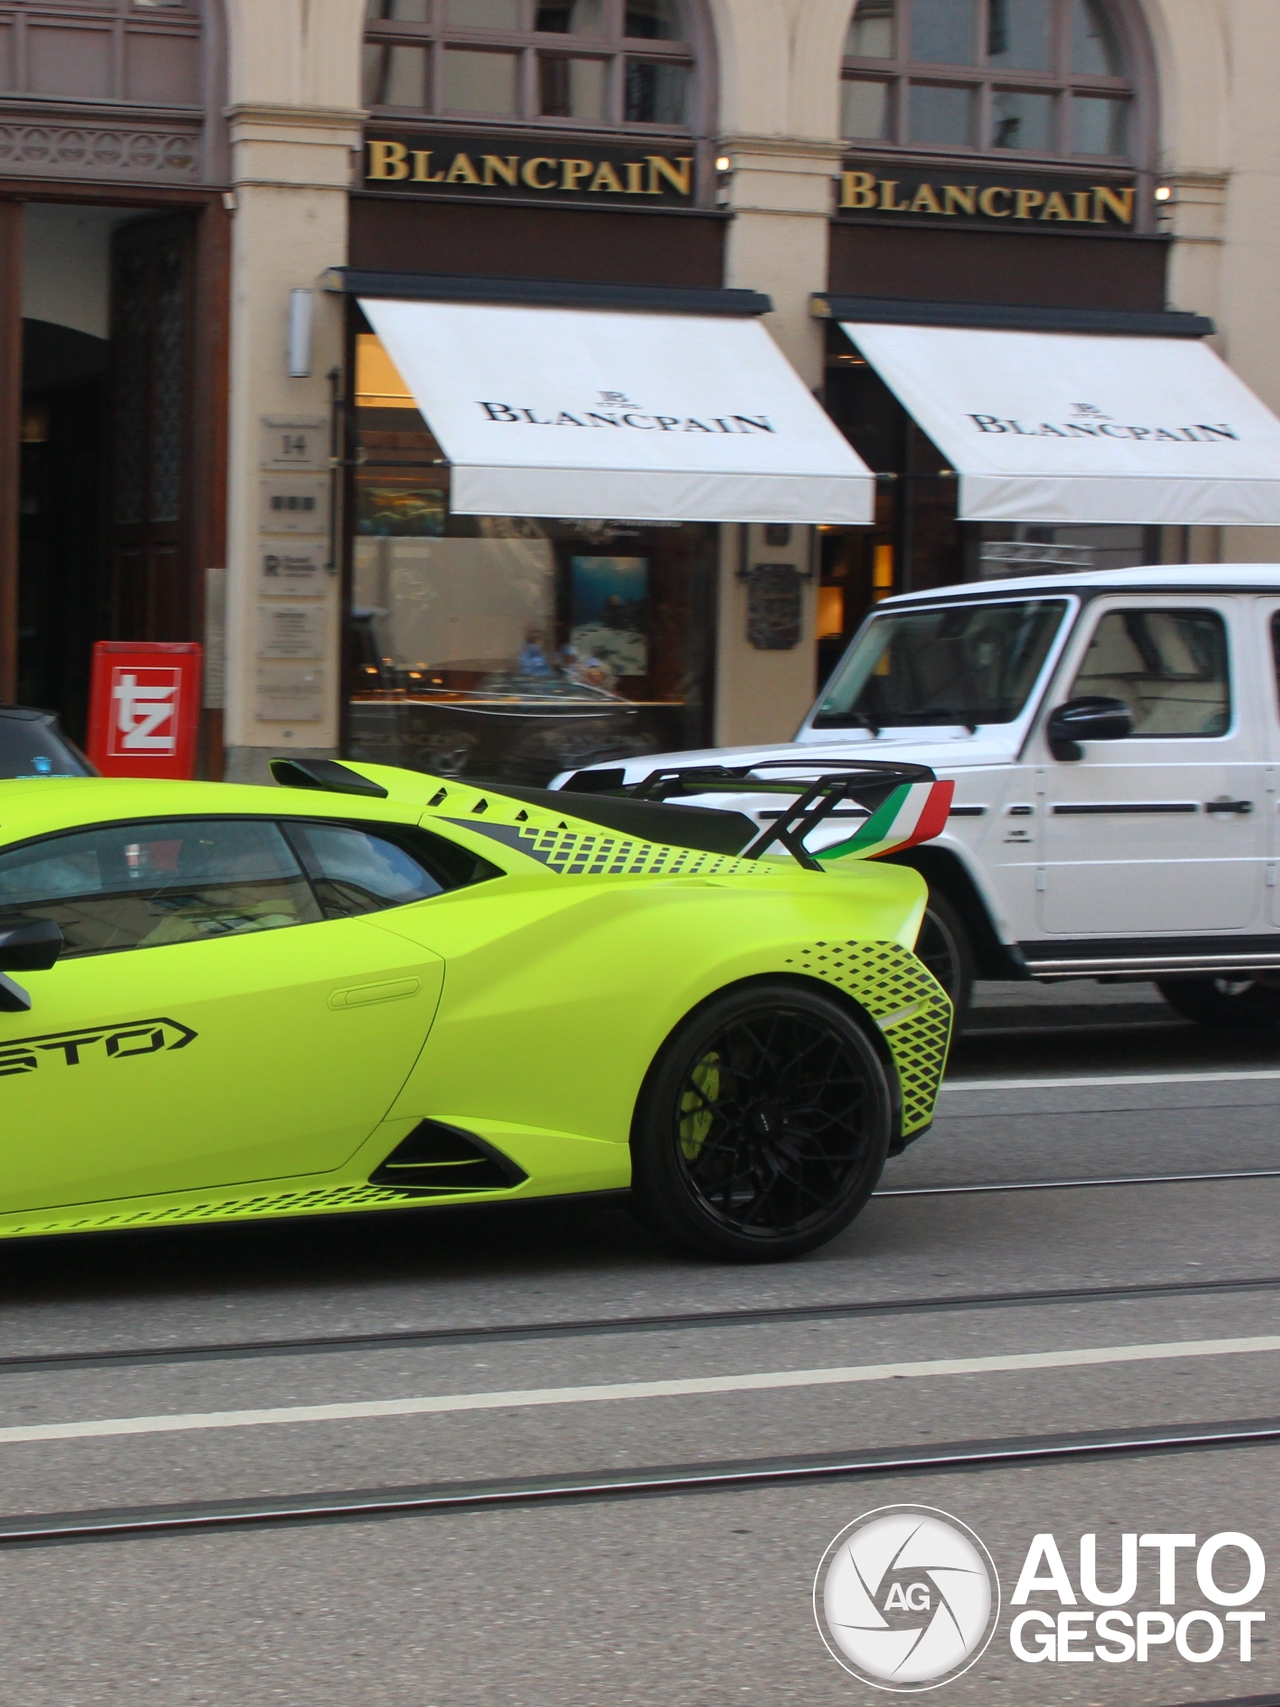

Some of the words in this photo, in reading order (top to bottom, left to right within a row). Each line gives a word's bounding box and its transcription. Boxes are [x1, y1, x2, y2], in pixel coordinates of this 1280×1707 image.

[365, 140, 694, 195] BLANCPAIN
[838, 171, 1136, 224] BLANCPAIN
[473, 401, 778, 434] BLANCPAIN
[965, 413, 1240, 442] BLANCPAIN
